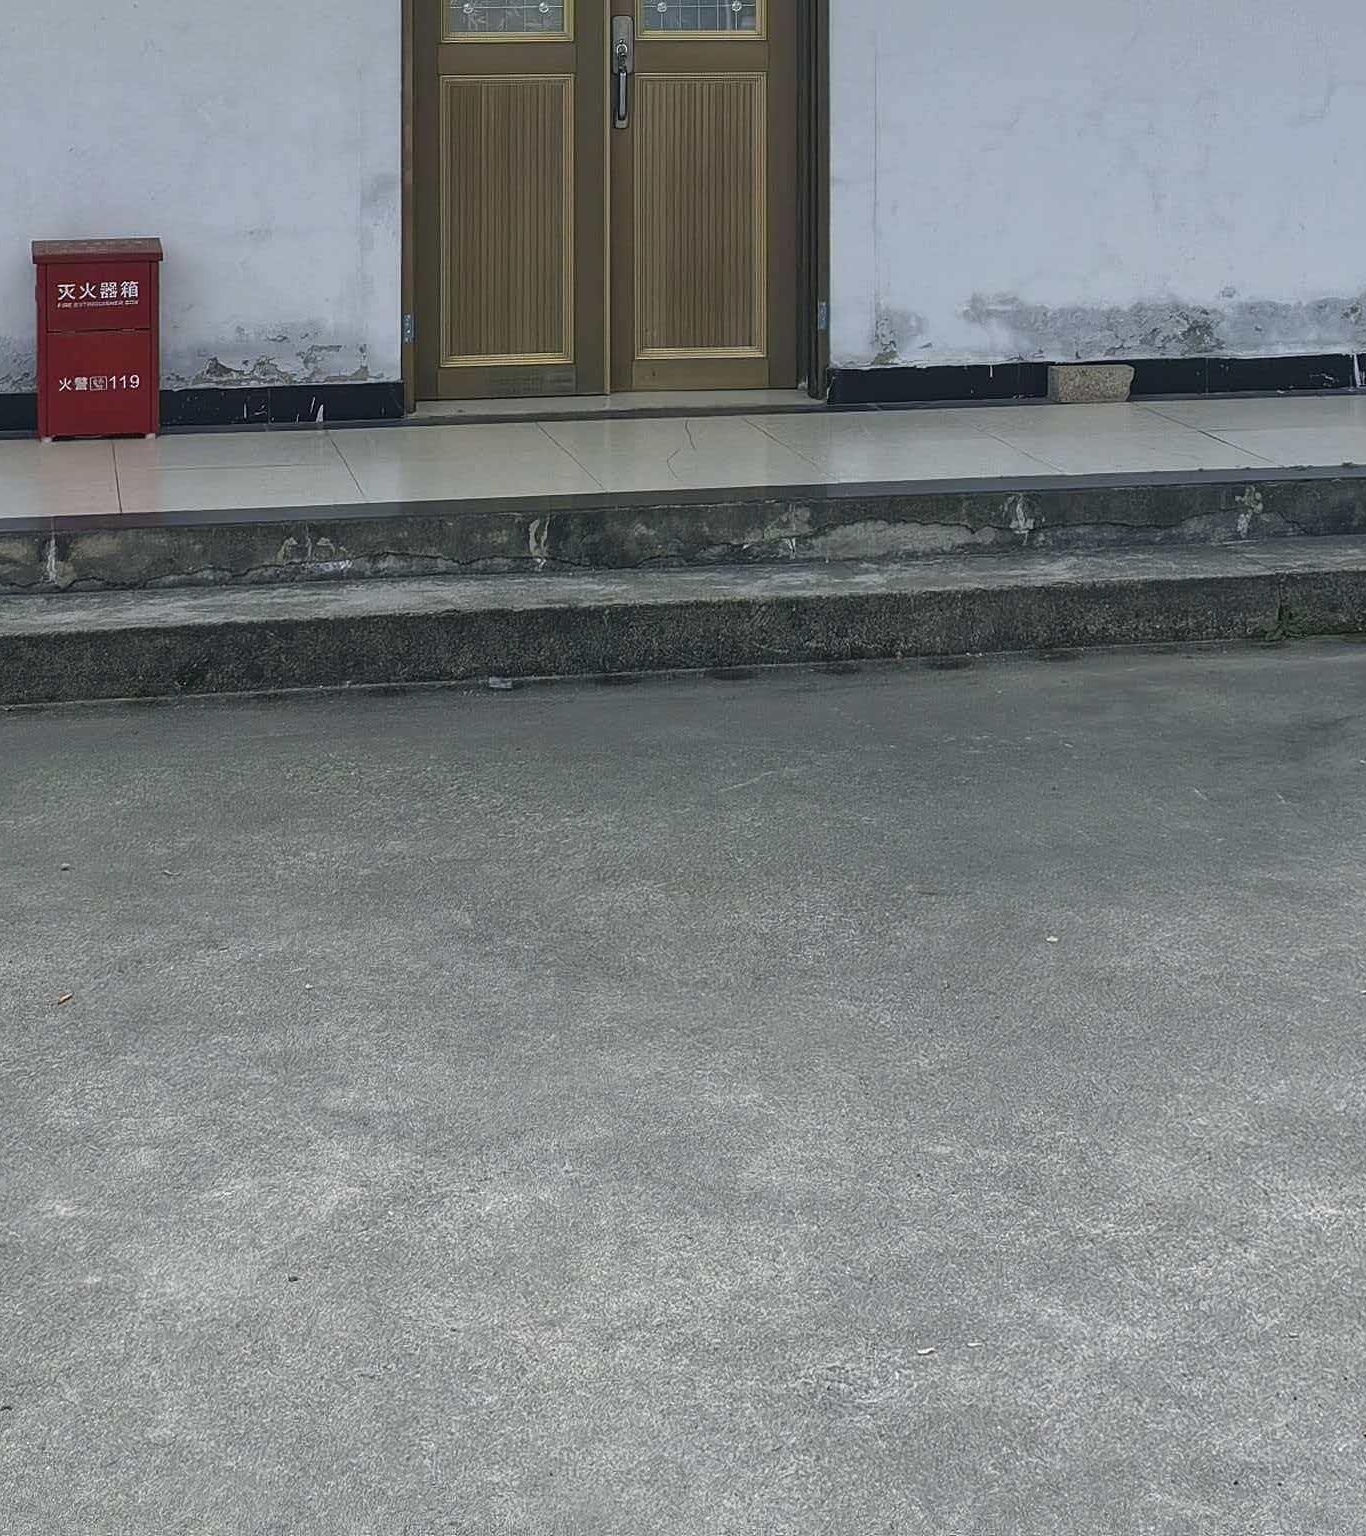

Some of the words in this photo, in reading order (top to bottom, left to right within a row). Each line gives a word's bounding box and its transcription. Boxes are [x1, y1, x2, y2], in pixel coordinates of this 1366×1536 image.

[57, 281, 139, 301] 灭火器箱
[58, 376, 89, 392] 火警
[109, 375, 140, 390] 119
